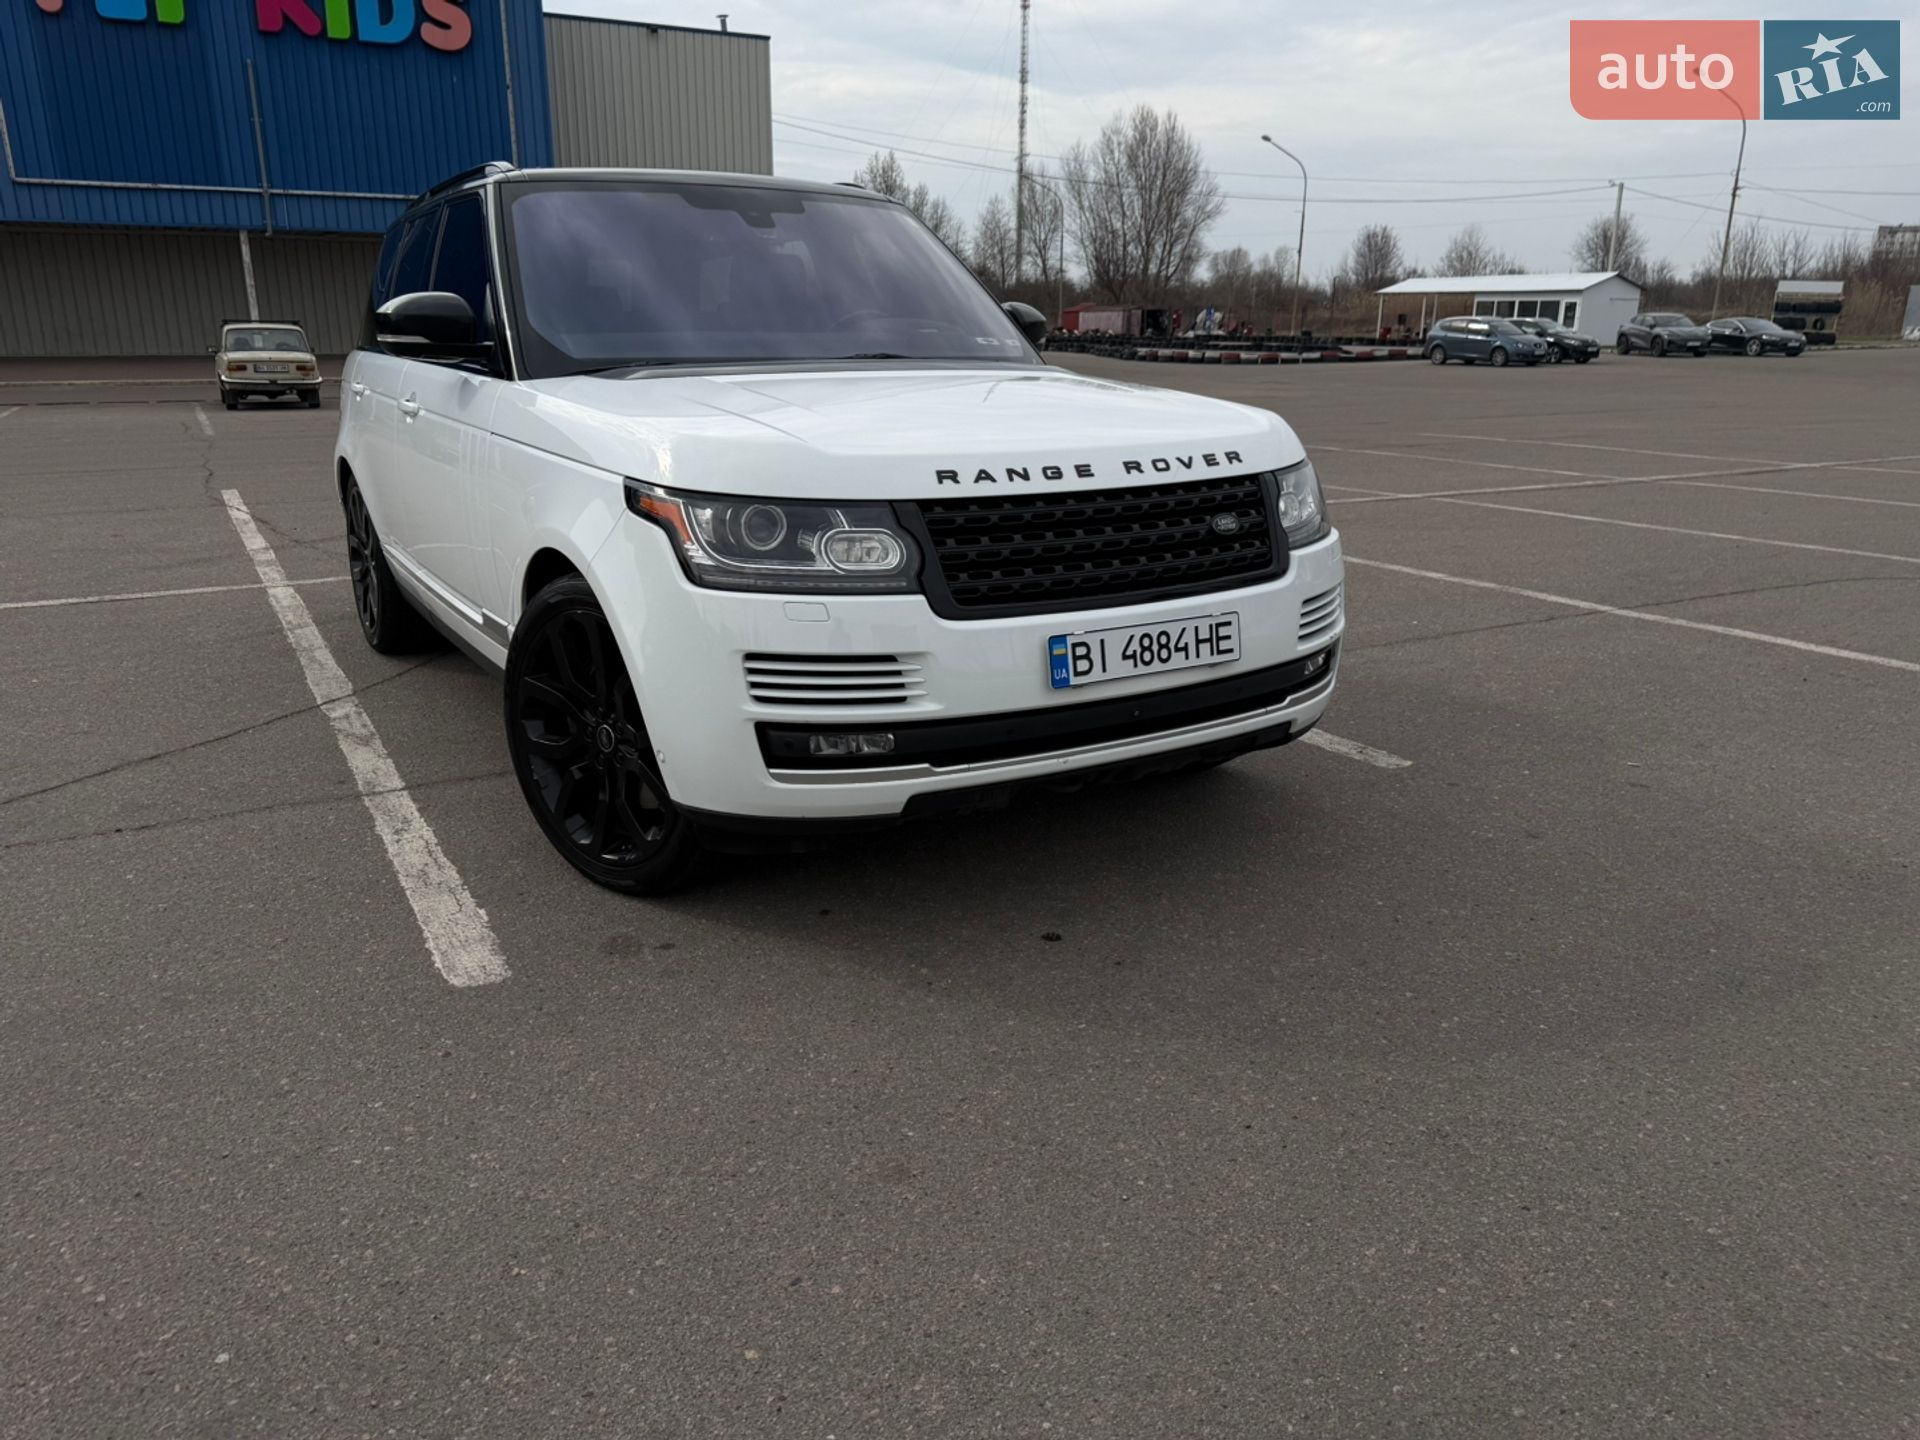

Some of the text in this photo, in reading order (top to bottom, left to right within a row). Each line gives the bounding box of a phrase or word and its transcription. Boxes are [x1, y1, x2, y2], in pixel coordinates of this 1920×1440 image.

[935, 450, 1243, 484] RANGE ROVER
[1054, 669, 1068, 680] UA
